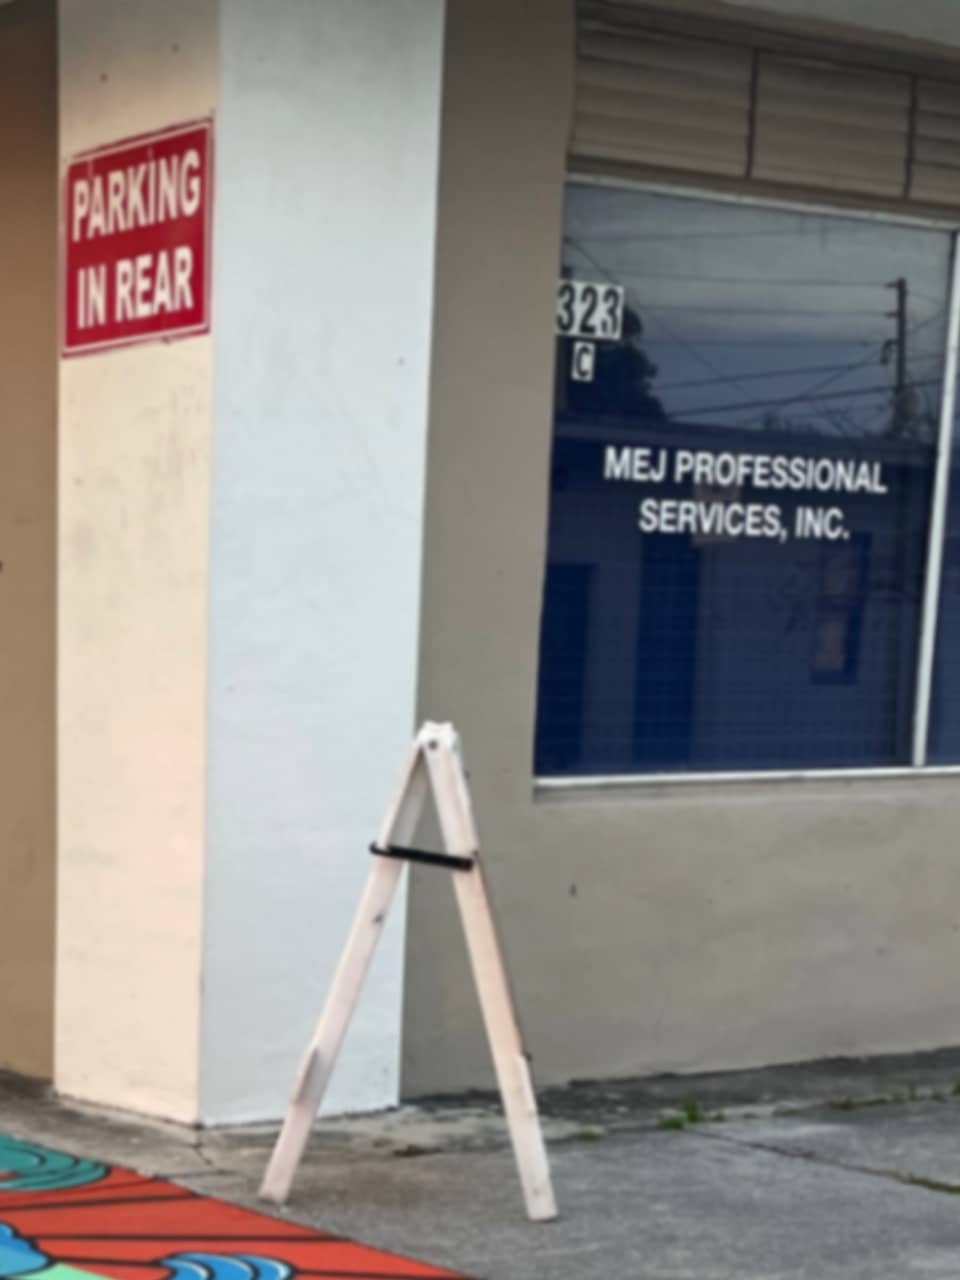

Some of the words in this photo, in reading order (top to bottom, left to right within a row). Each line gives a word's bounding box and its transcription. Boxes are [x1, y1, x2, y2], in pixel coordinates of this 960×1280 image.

[71, 149, 202, 242] PARKING
[77, 264, 108, 329] IN
[115, 246, 193, 321] REAR
[557, 284, 621, 337] 323
[573, 346, 593, 378] C
[603, 446, 667, 481] MEJ
[674, 451, 887, 494] PROFESSIONAL
[638, 499, 787, 541] SERVICES,
[795, 507, 849, 540] INC.
